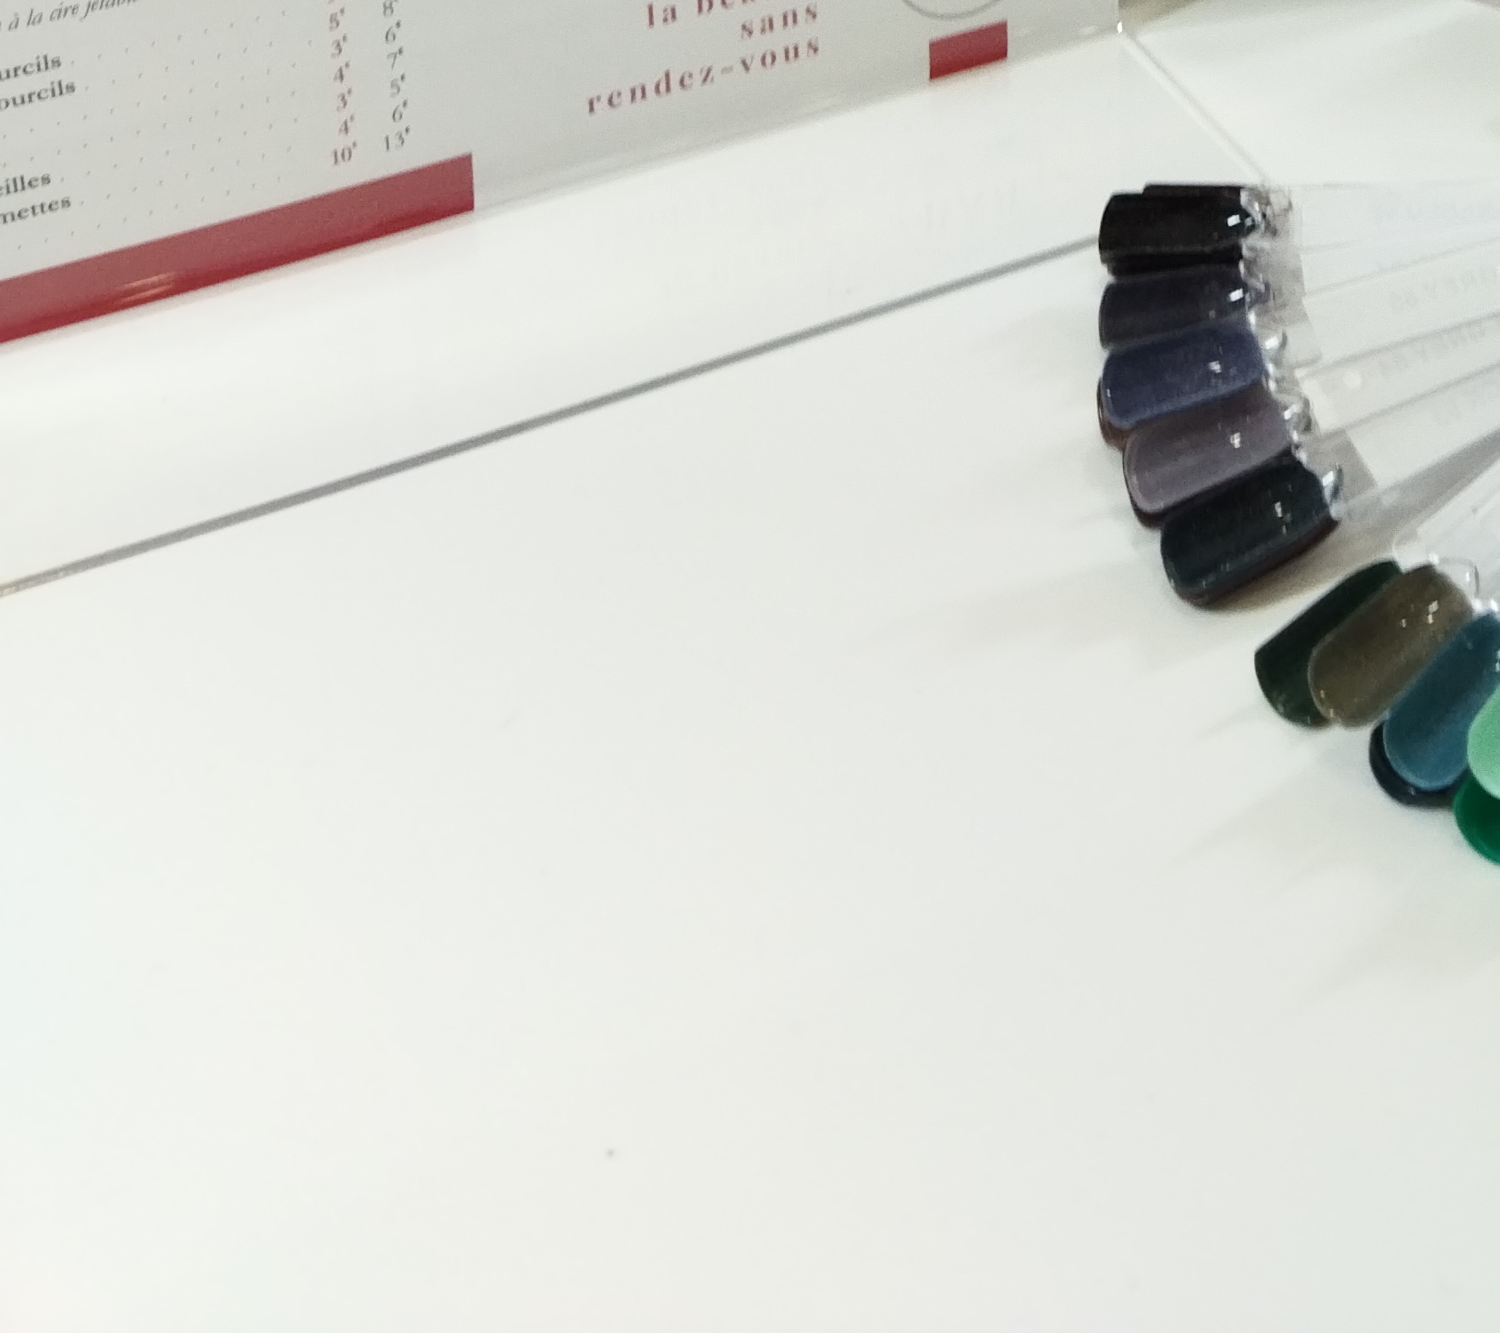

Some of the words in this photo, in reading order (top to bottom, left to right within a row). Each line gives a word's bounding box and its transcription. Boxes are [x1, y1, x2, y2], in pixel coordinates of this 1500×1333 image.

[8, 12, 20, 31] à
[26, 8, 45, 29] la
[49, 0, 80, 22] cire
[645, 3, 677, 30] la
[740, 3, 819, 41] sans
[587, 37, 822, 117] rendez-vous
